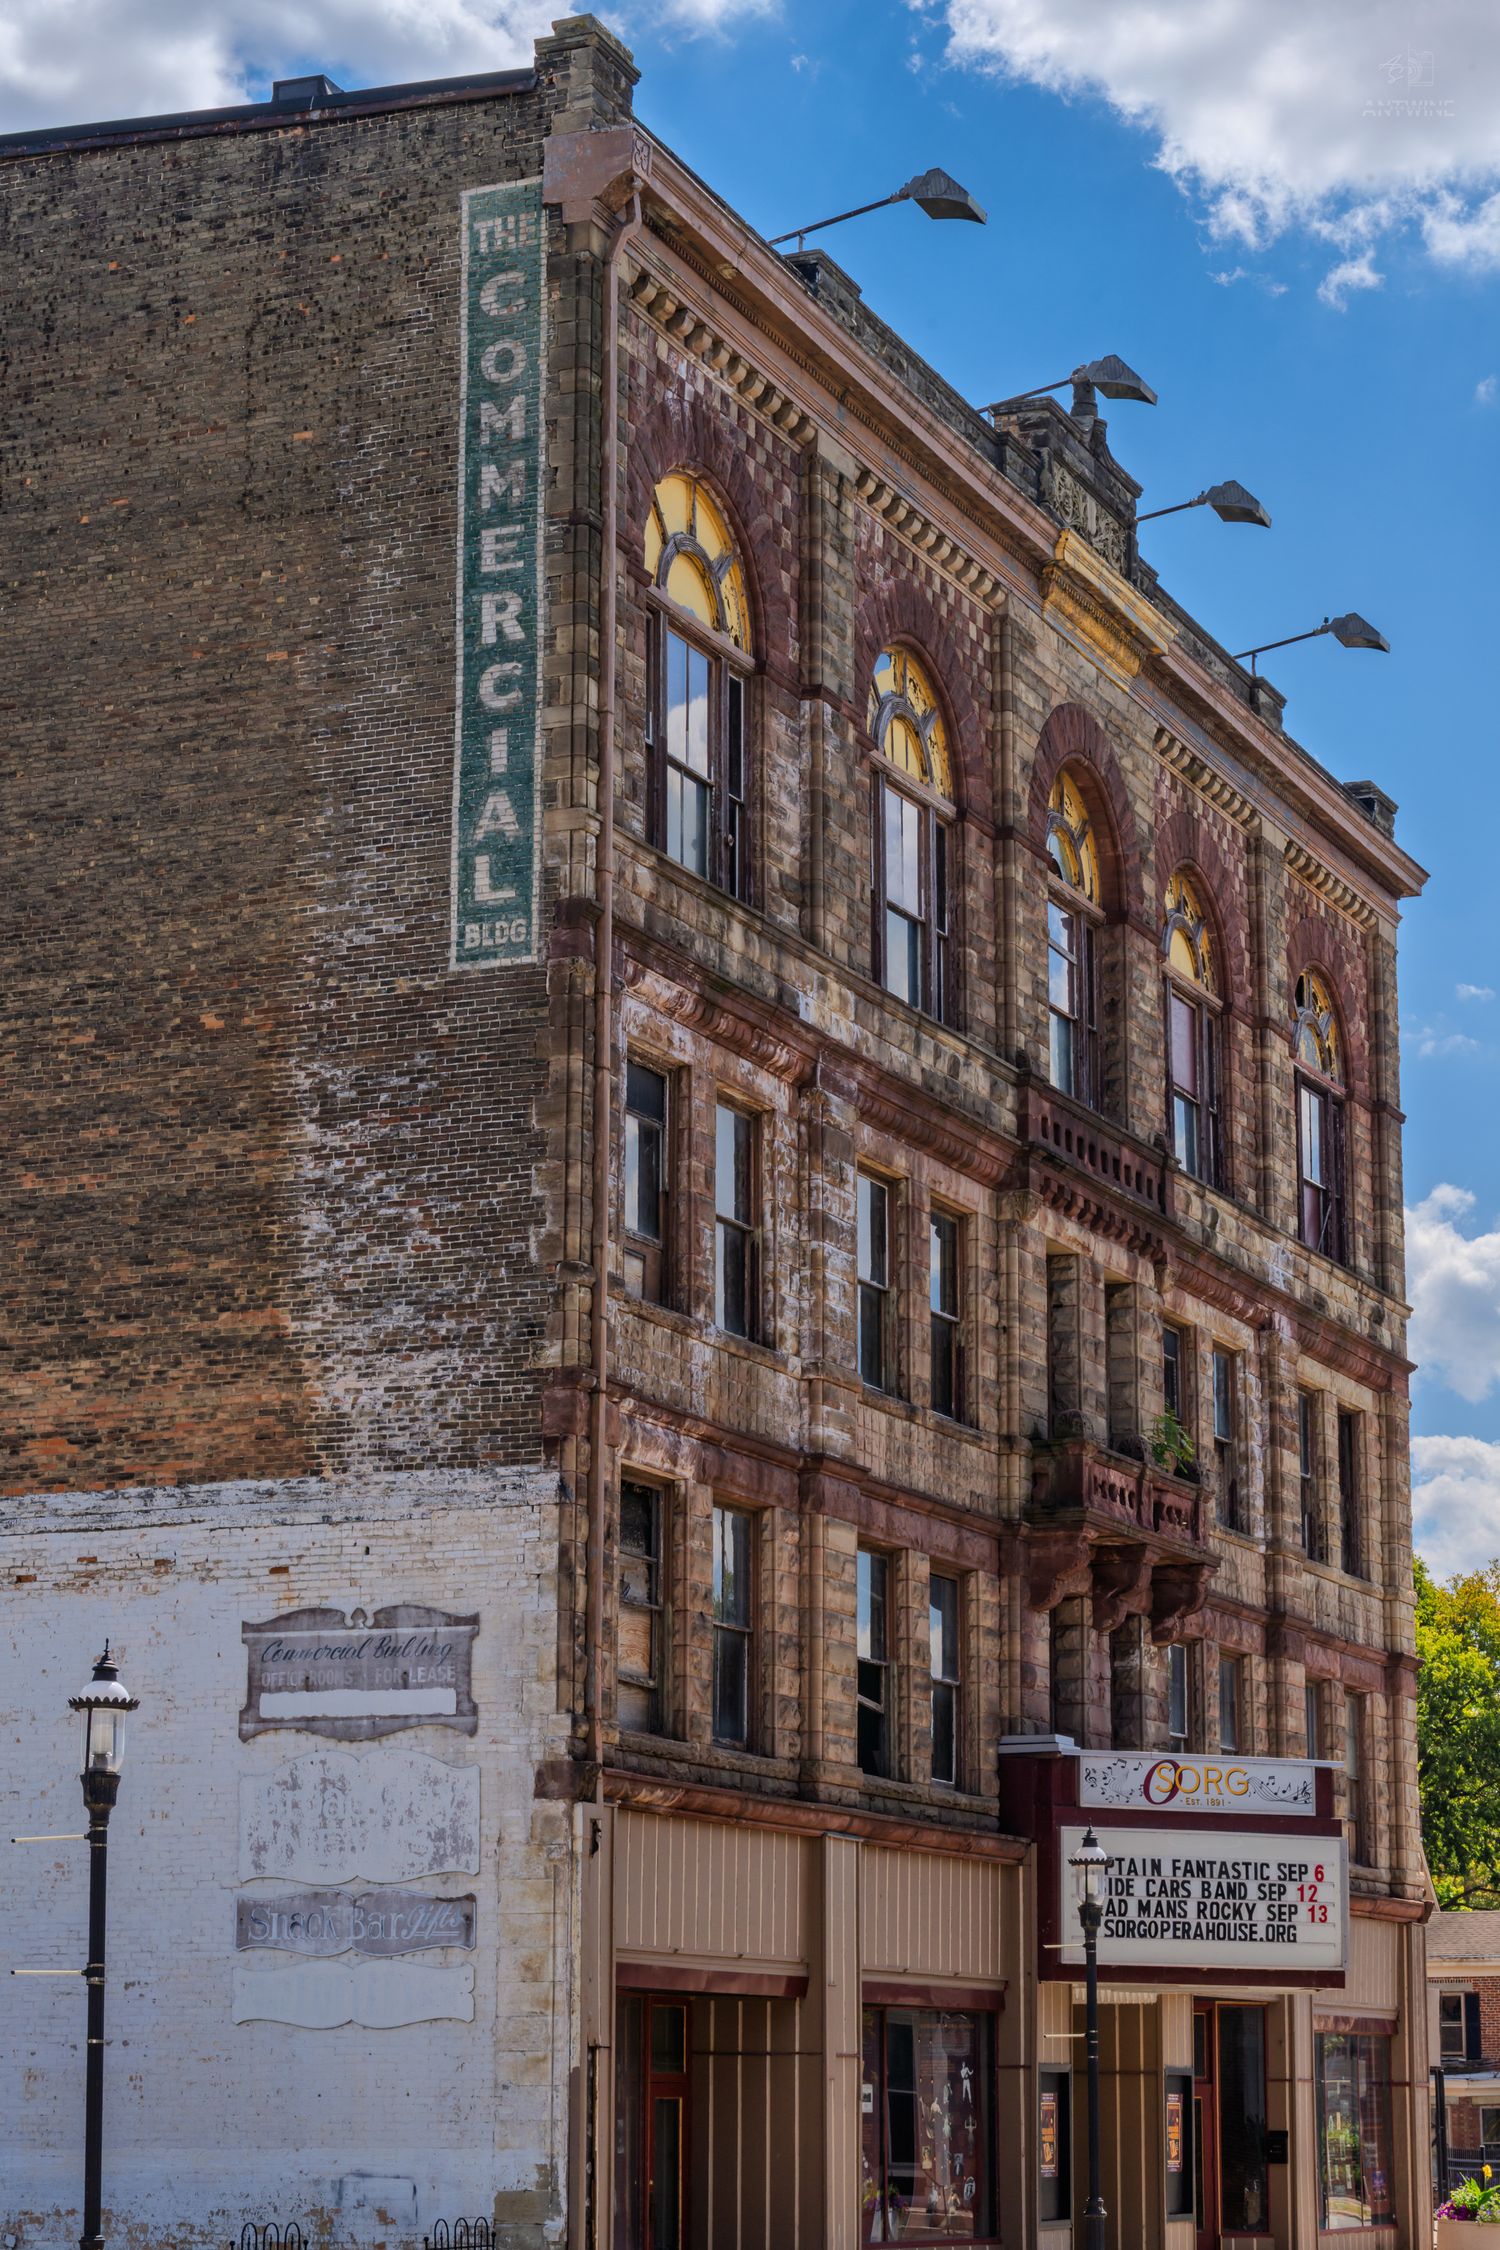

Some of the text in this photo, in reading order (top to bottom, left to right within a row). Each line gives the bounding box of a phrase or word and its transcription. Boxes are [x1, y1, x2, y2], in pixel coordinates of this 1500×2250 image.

[473, 211, 536, 254] THE
[473, 270, 528, 901] COMMERCIAL
[464, 918, 528, 949] BLDG
[375, 1668, 405, 1684] FOR
[408, 1666, 456, 1683] LEASE
[1155, 1764, 1250, 1796] SORG
[1206, 1798, 1225, 1807] 1891
[1105, 1856, 1325, 1883] PTAIN FANTASTIC SEP 6
[1105, 1877, 1318, 1903] IDE CARS BAND SEP 12
[249, 1905, 340, 1941] Snack
[350, 1905, 407, 1941] Bar
[1102, 1898, 1329, 1924] AD MANS ROCKY SEP 13
[1104, 1918, 1298, 1943] SORGOPERAHOUSE.ORG
